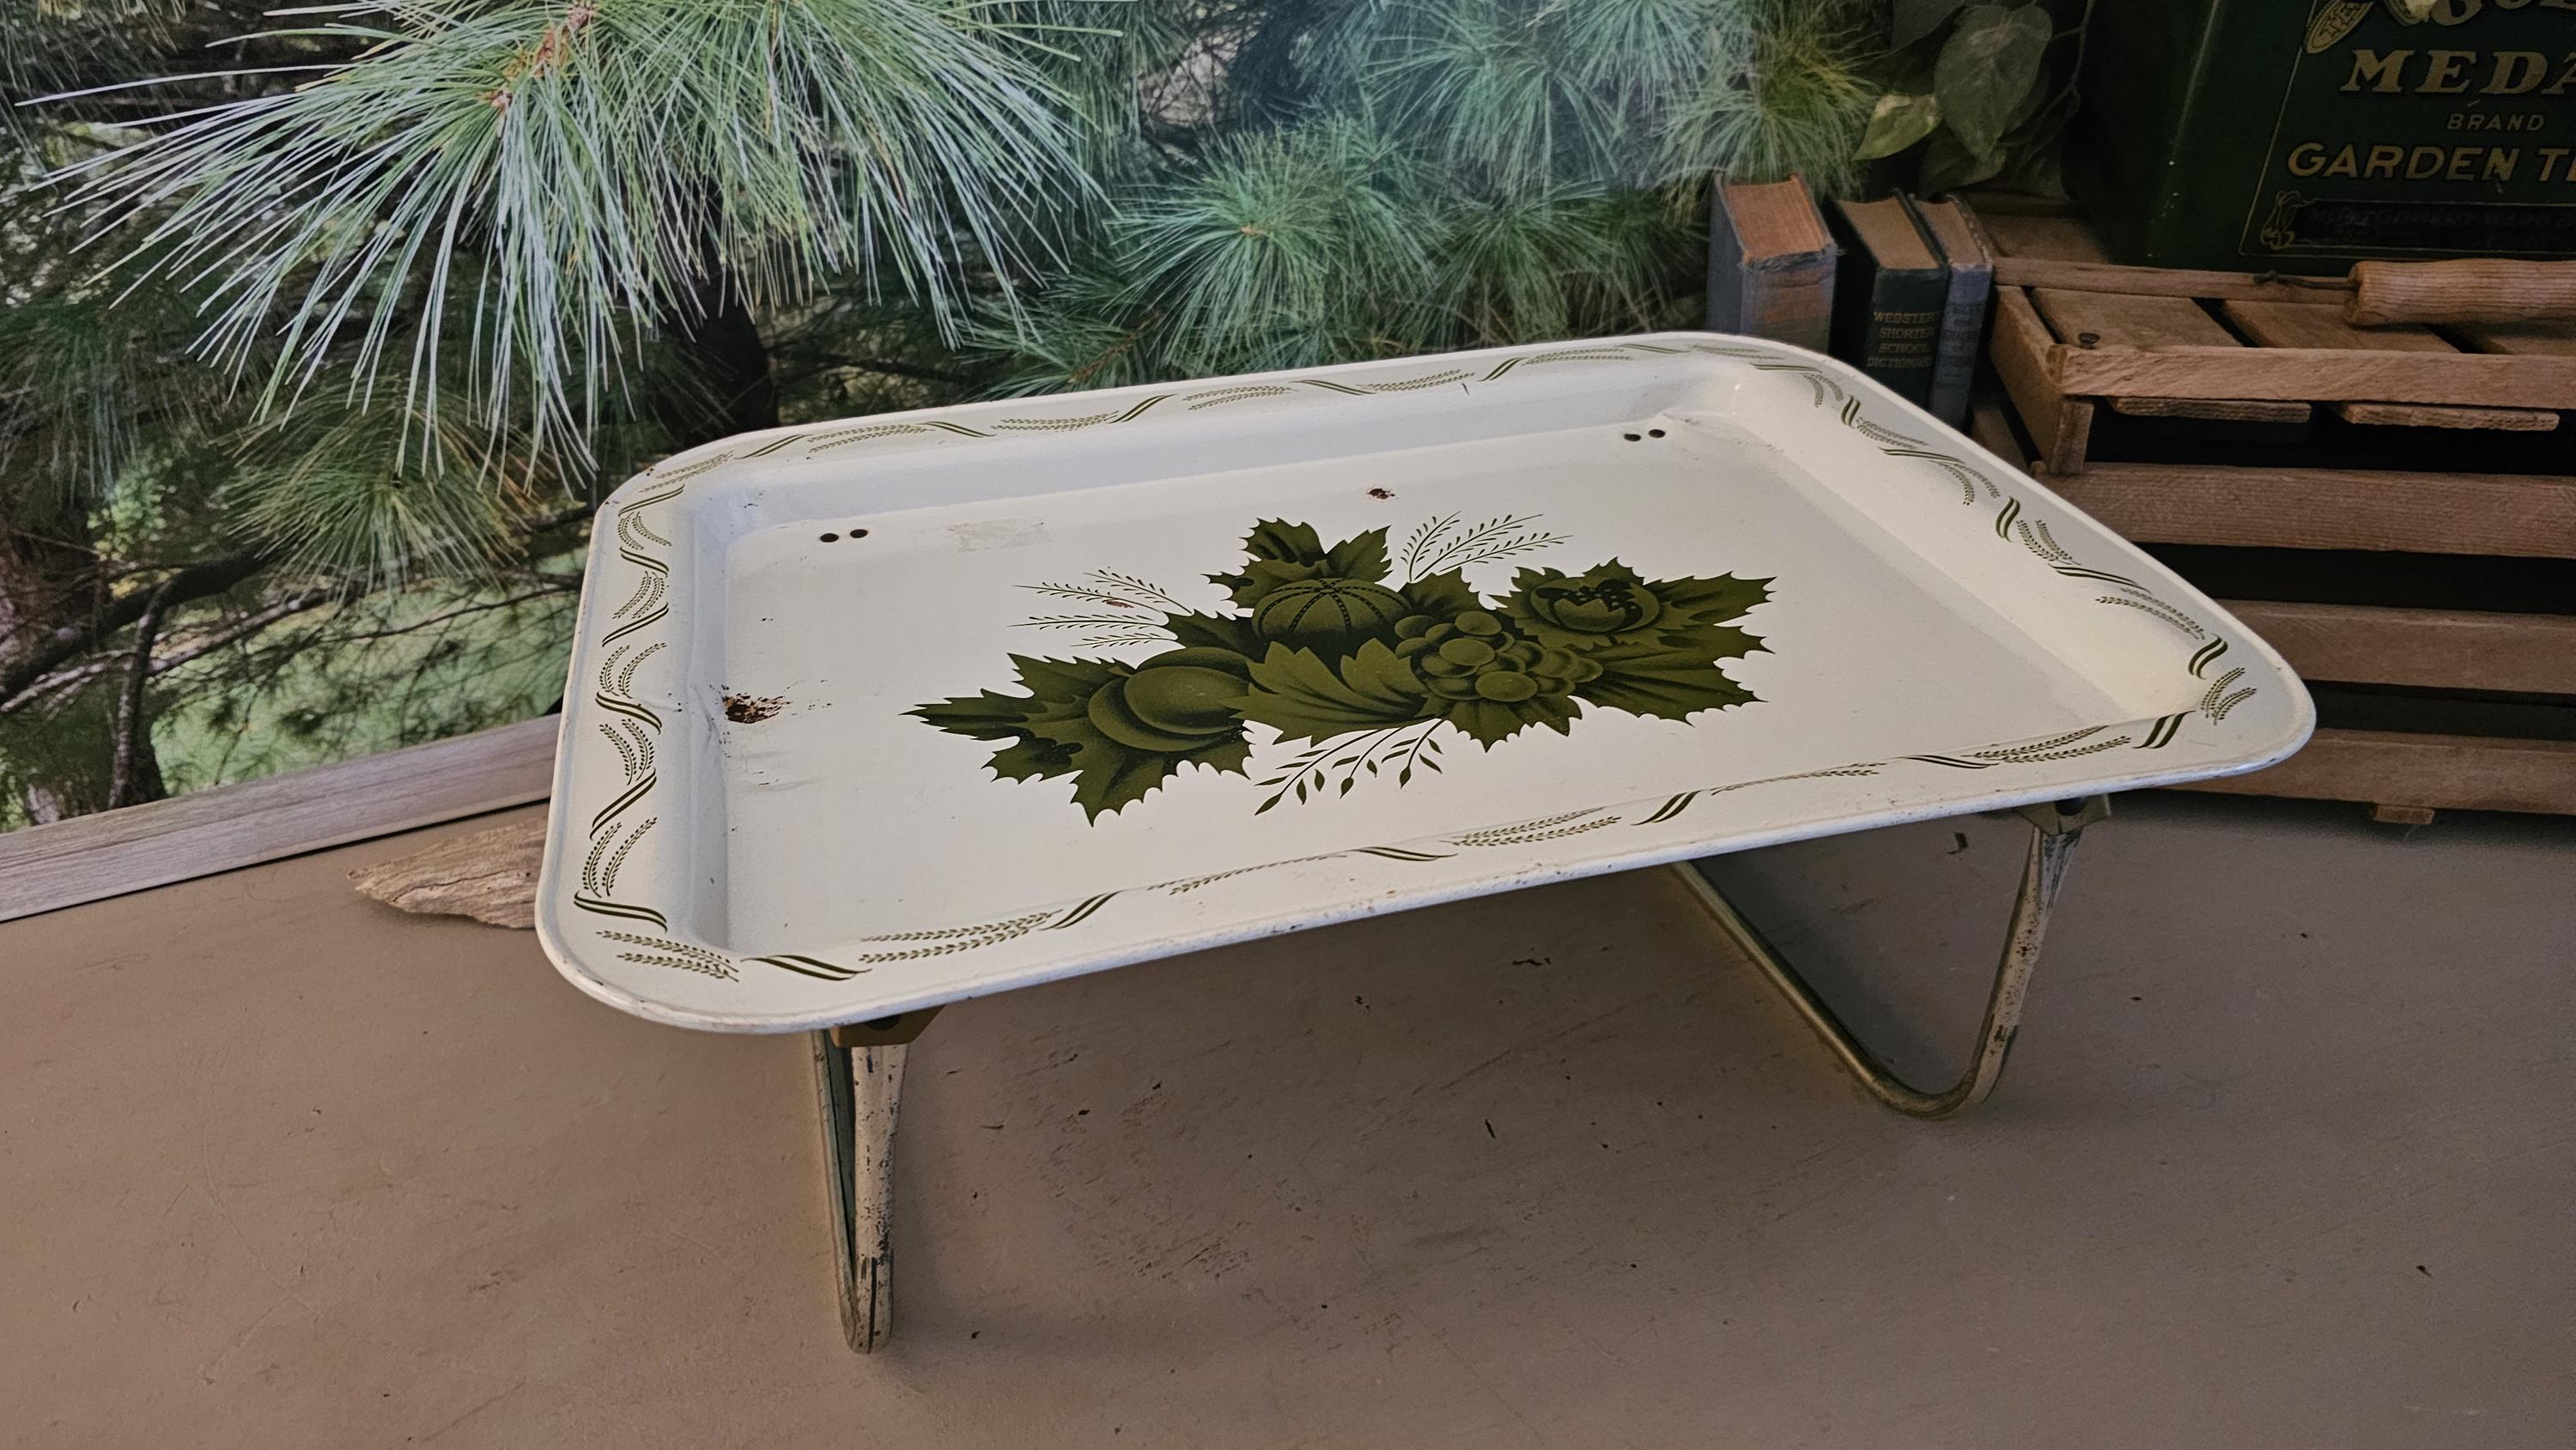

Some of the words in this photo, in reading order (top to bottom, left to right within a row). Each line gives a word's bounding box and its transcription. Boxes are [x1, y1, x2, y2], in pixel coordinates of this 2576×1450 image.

[2446, 113, 2545, 131] BRAND
[2287, 142, 2520, 181] GARDEN
[1878, 343, 1930, 354] SCHOOL
